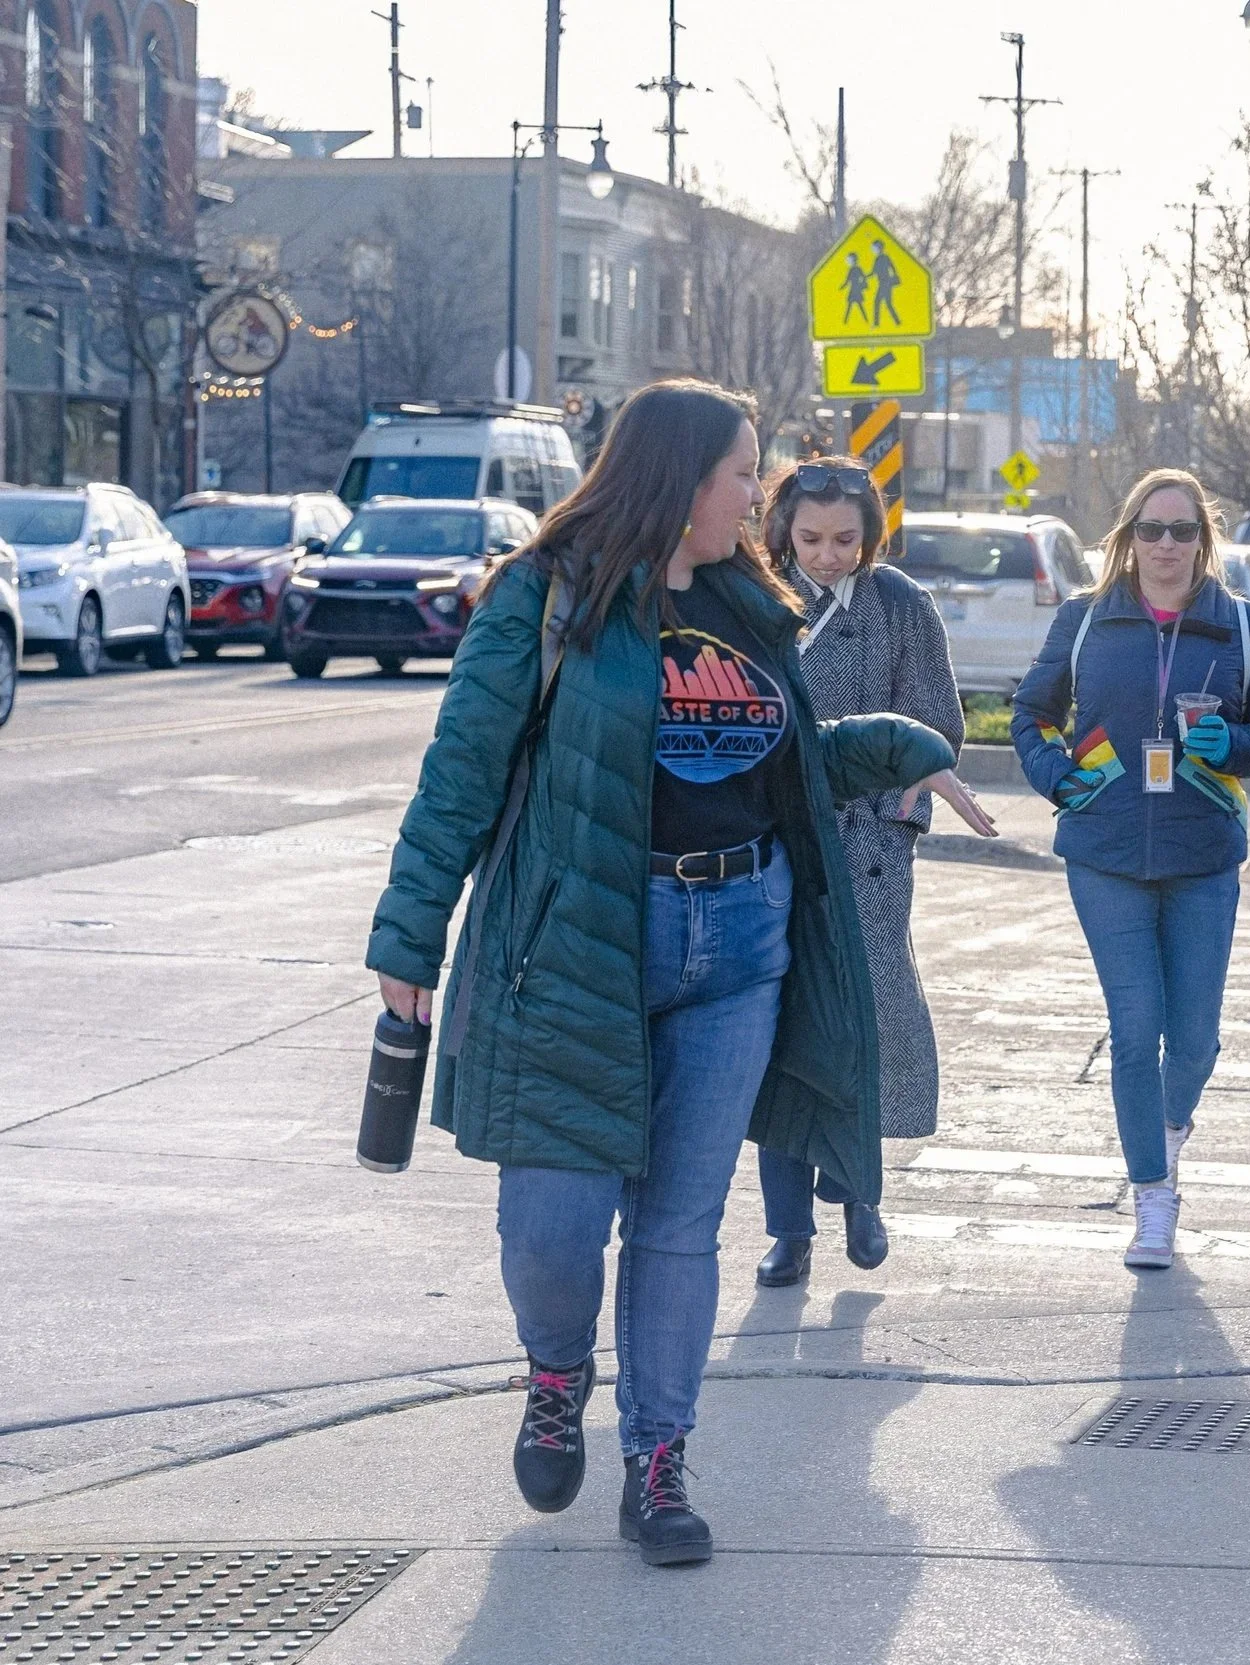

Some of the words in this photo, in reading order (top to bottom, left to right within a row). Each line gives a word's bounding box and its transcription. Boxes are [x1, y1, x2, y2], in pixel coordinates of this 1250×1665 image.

[659, 702, 712, 723] ASTE
[717, 706, 741, 722] OF
[746, 703, 779, 725] GR
